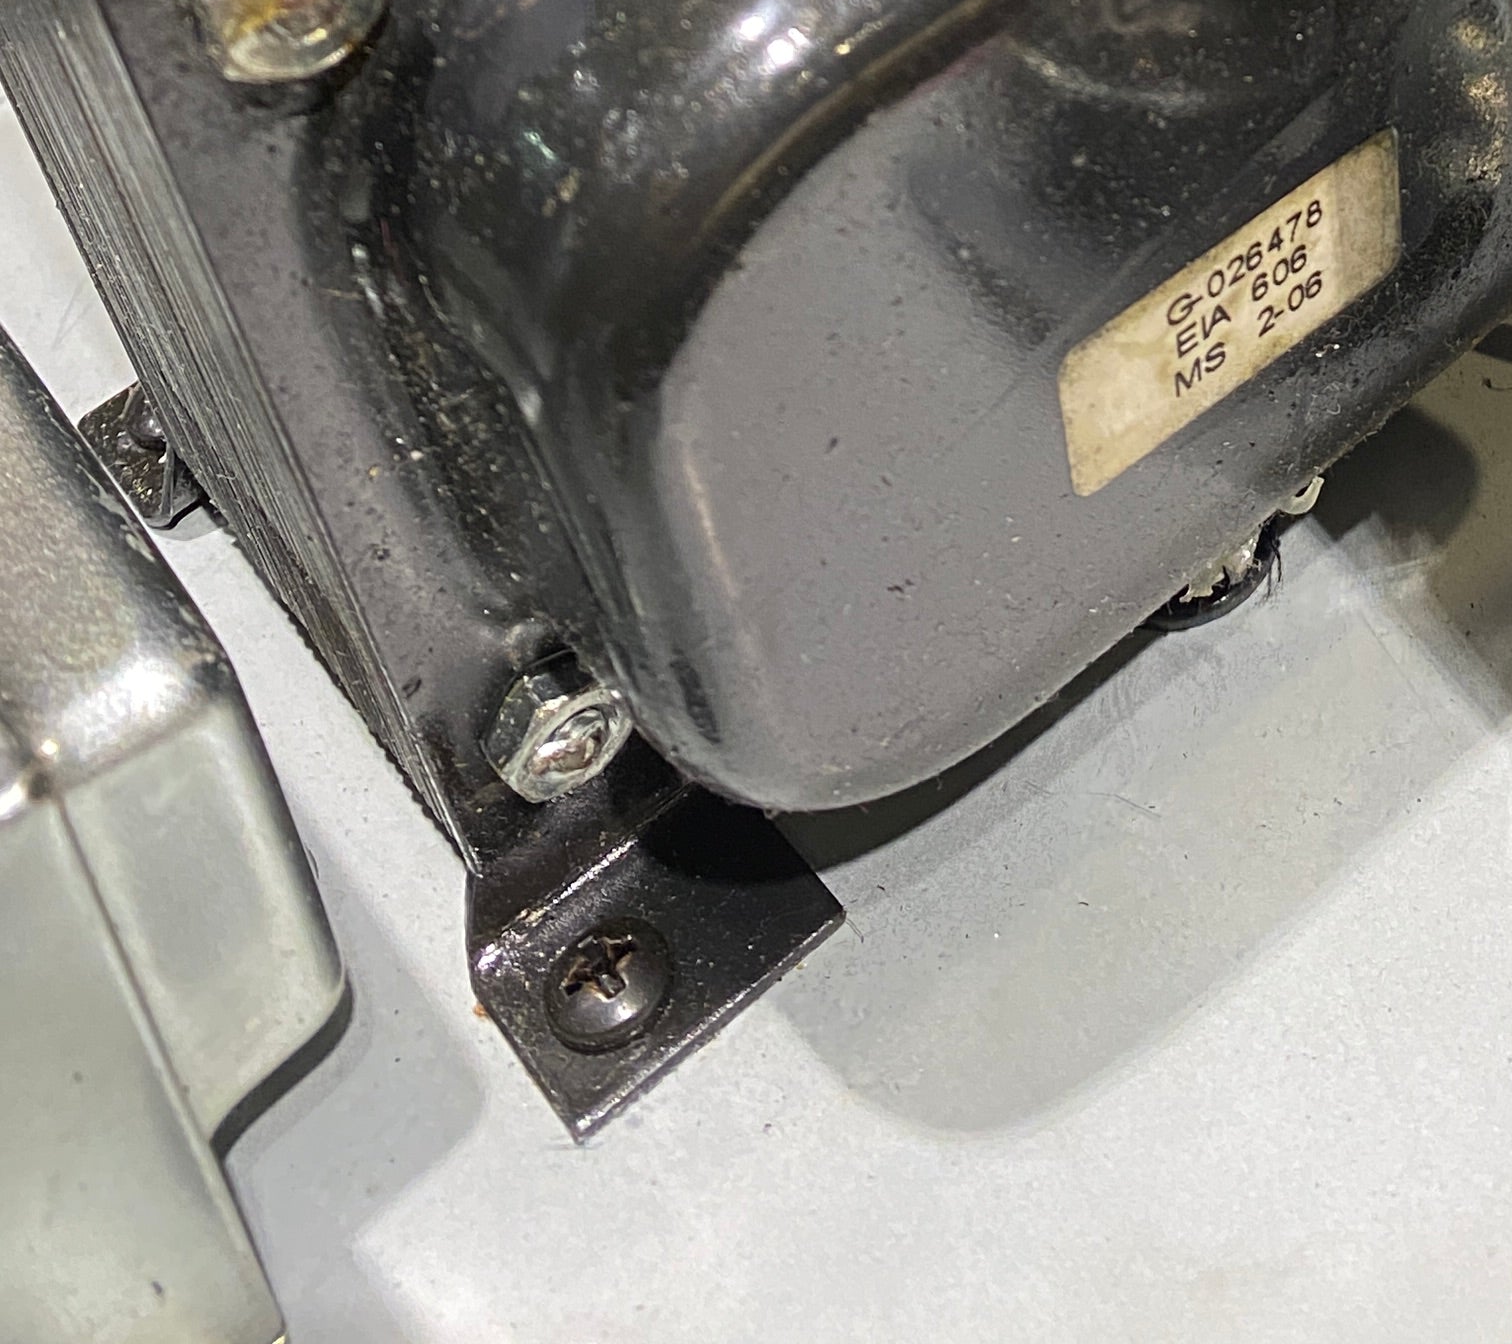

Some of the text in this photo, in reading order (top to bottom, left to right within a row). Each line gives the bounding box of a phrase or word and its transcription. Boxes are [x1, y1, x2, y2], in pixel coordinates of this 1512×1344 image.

[1166, 199, 1323, 327] G-026478
[1176, 244, 1308, 359] EIA 606
[1173, 270, 1323, 398] MS 2-06
